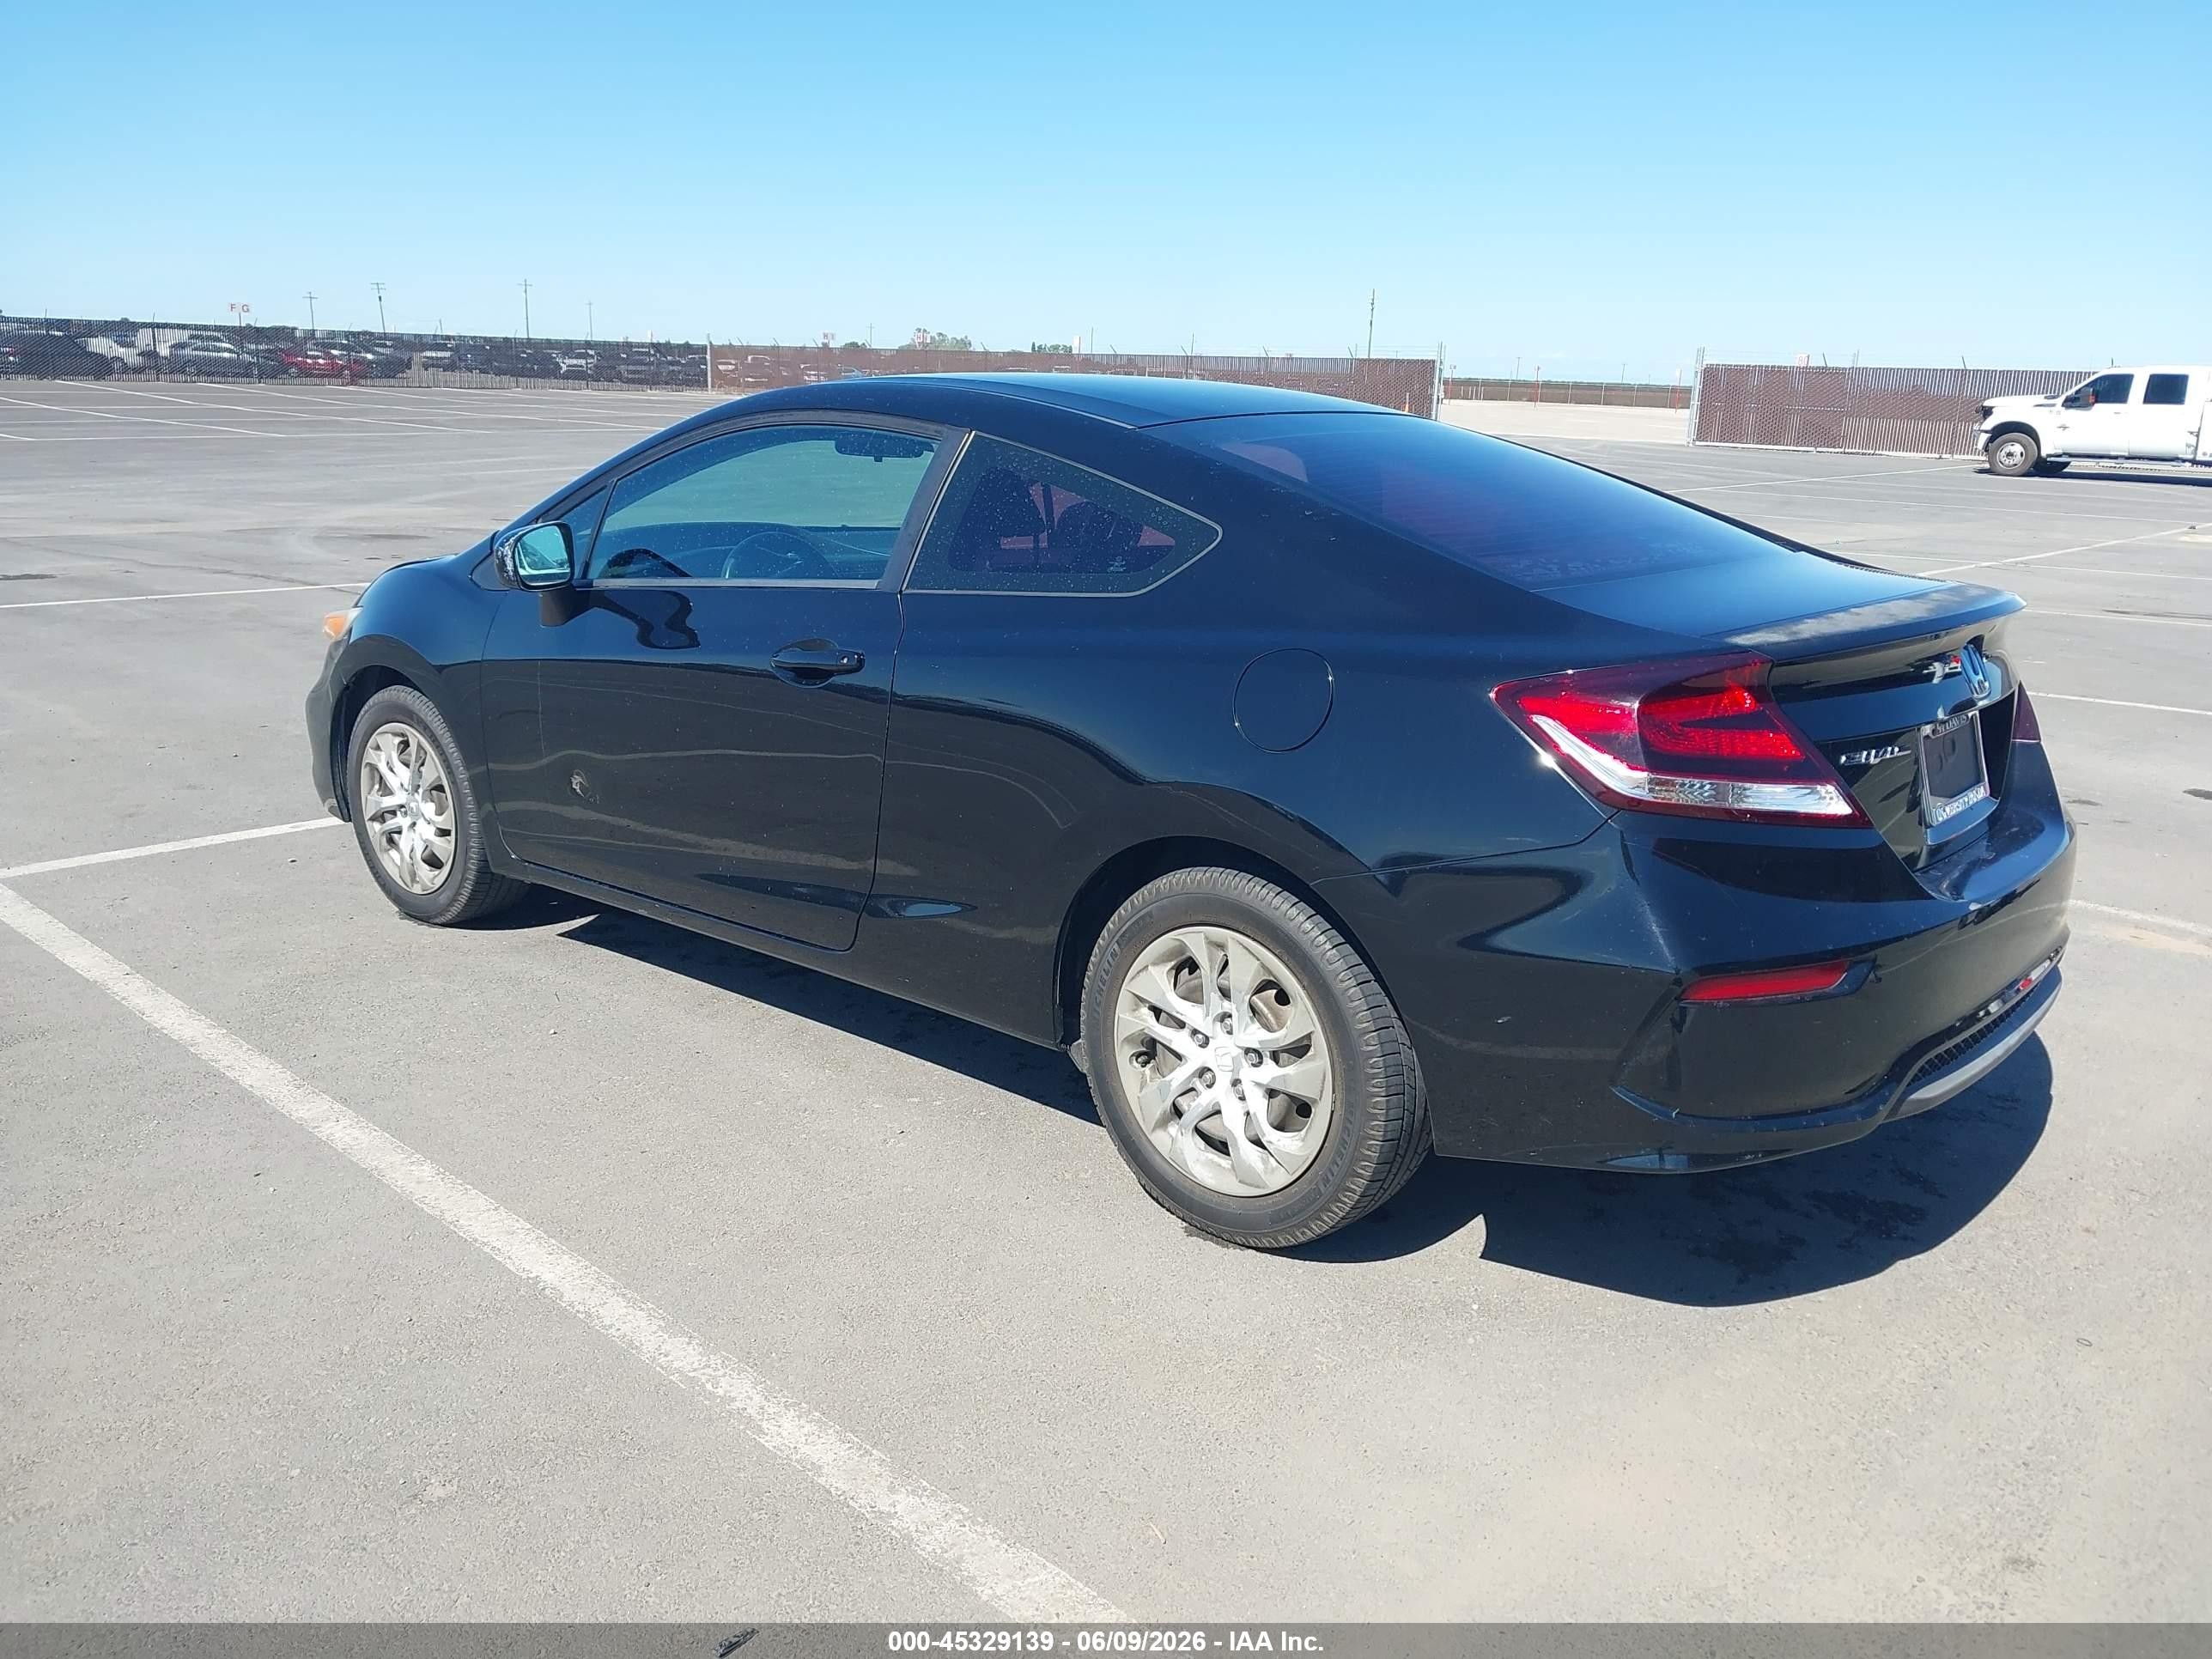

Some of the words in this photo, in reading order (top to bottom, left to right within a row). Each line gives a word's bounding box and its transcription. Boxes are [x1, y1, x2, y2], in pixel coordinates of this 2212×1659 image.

[230, 302, 236, 312] F
[241, 304, 250, 313] G
[1946, 714, 1967, 730] DAVIS
